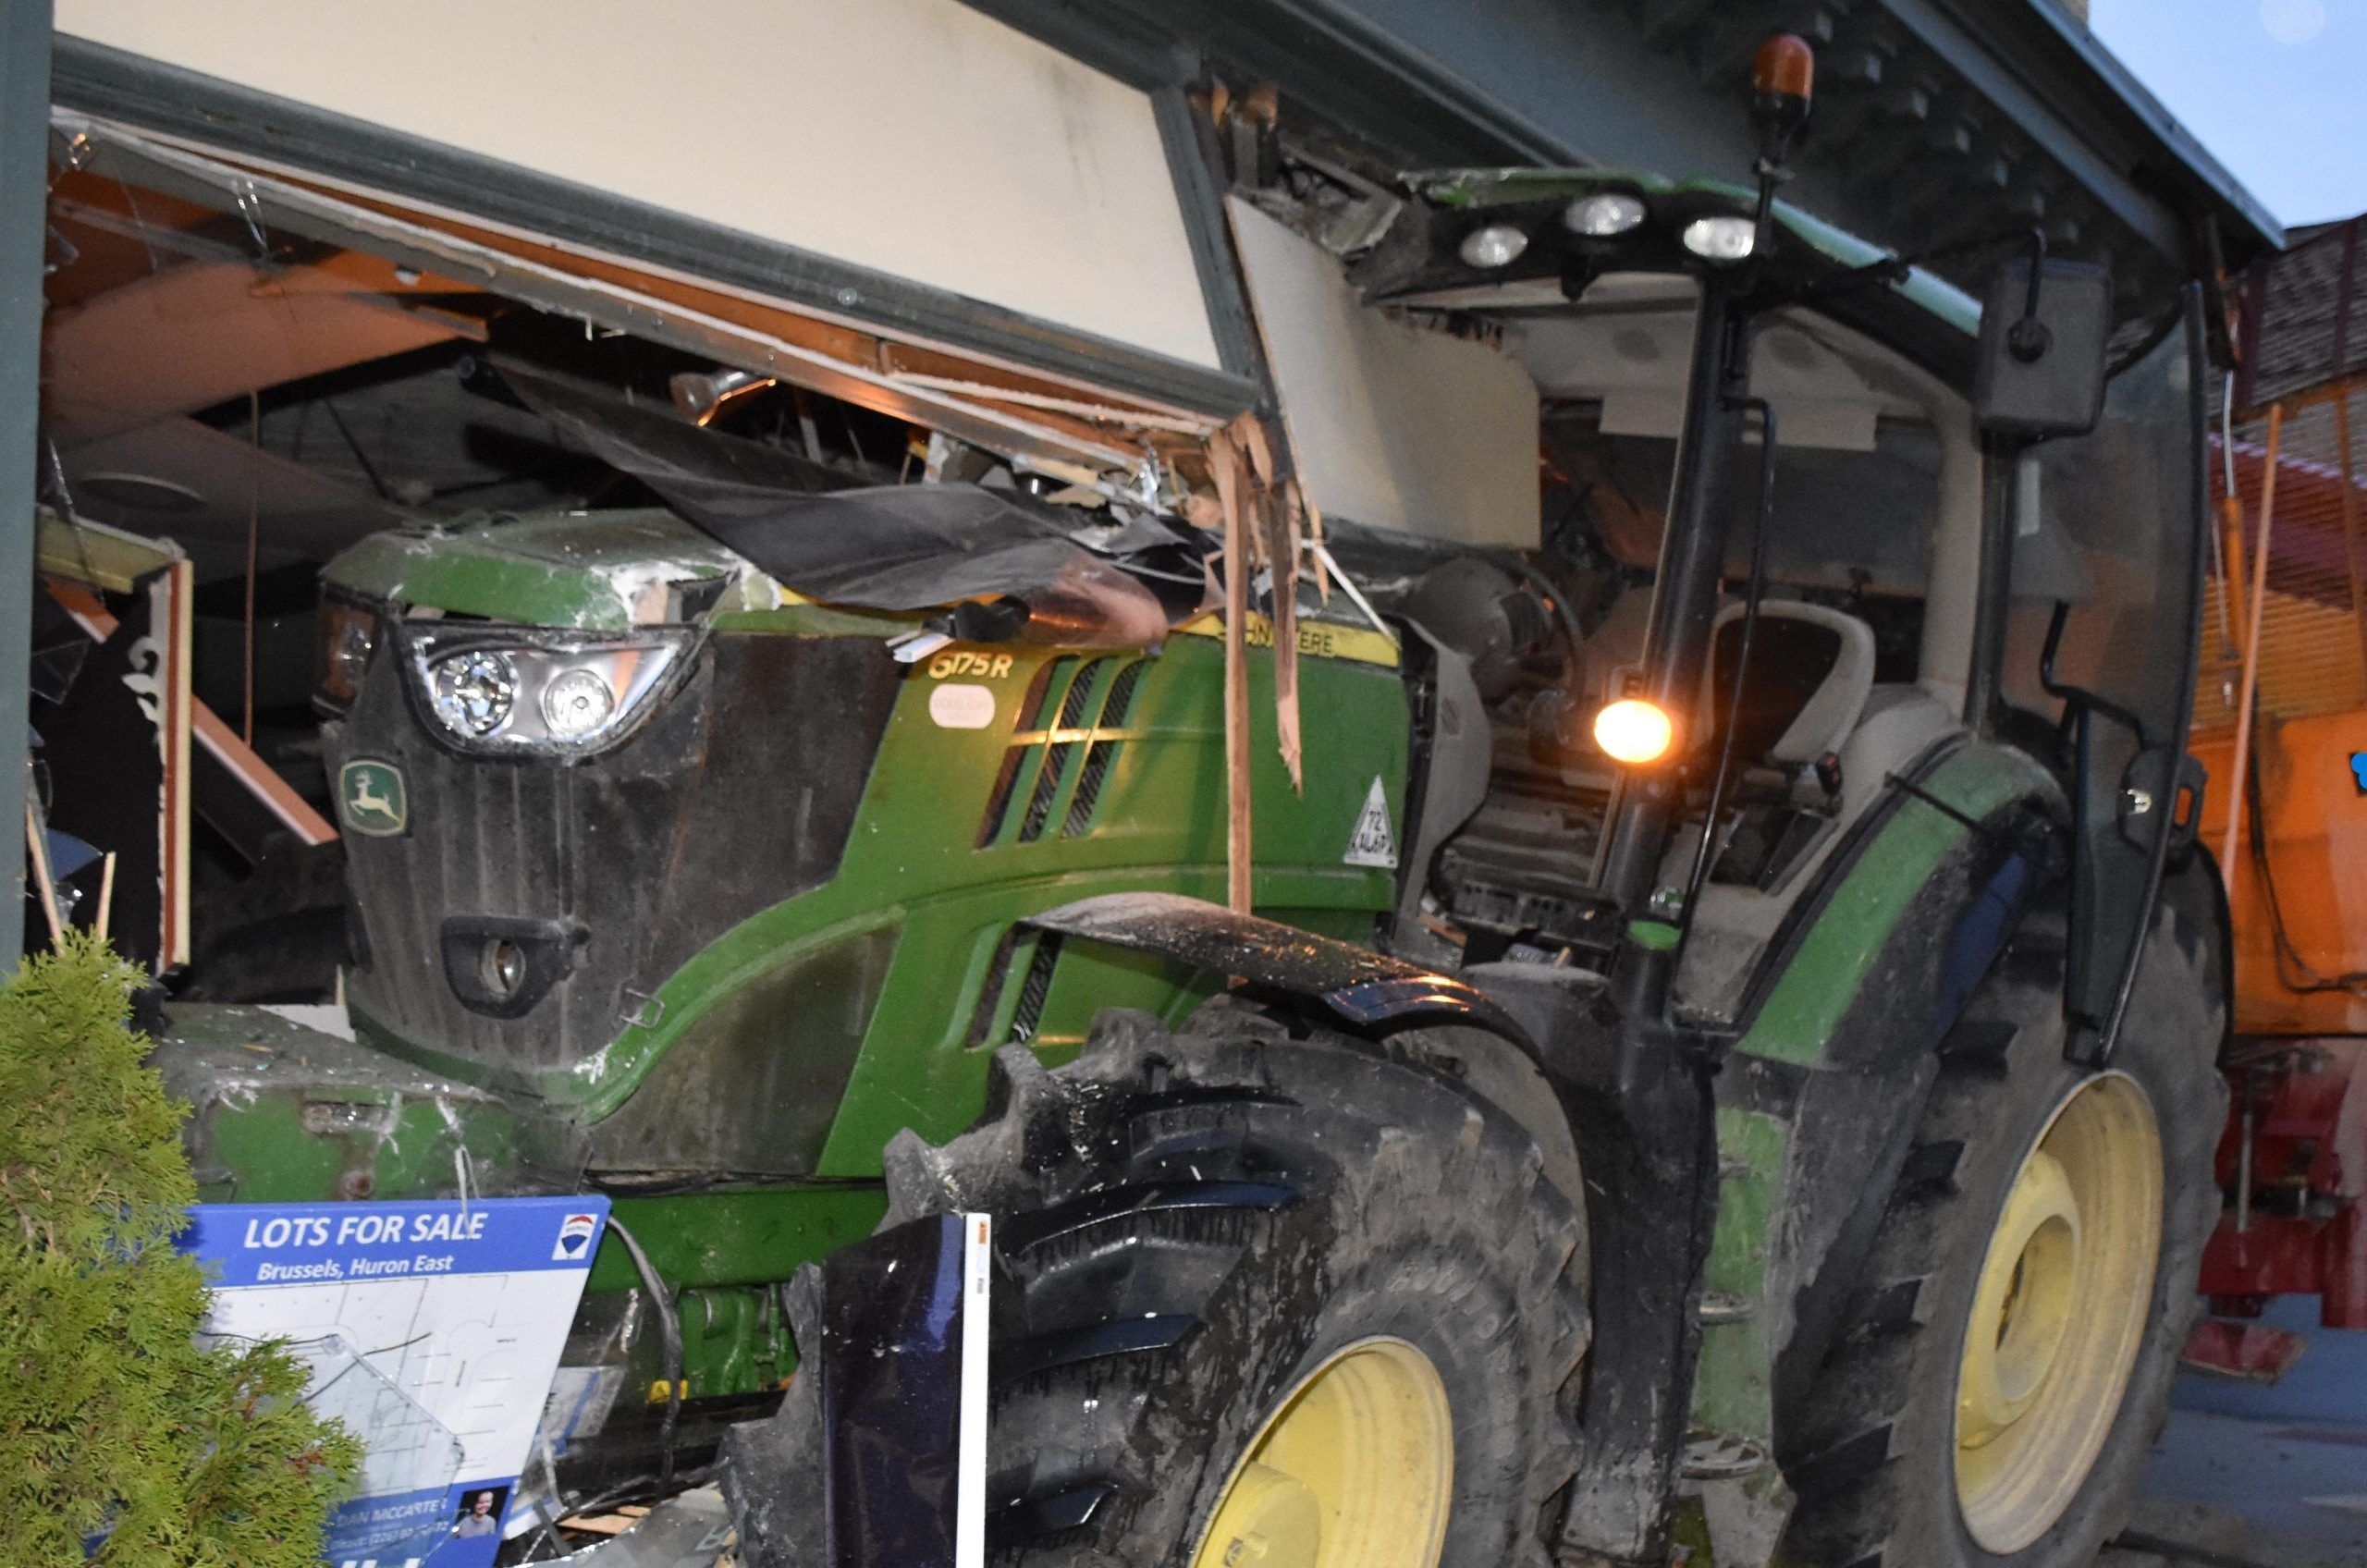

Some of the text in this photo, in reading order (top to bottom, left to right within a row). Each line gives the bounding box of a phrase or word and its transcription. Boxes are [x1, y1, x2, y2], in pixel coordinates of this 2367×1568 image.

[244, 1211, 489, 1249] LOTS FOR SALE
[257, 1255, 454, 1281] Brussels, Huron East
